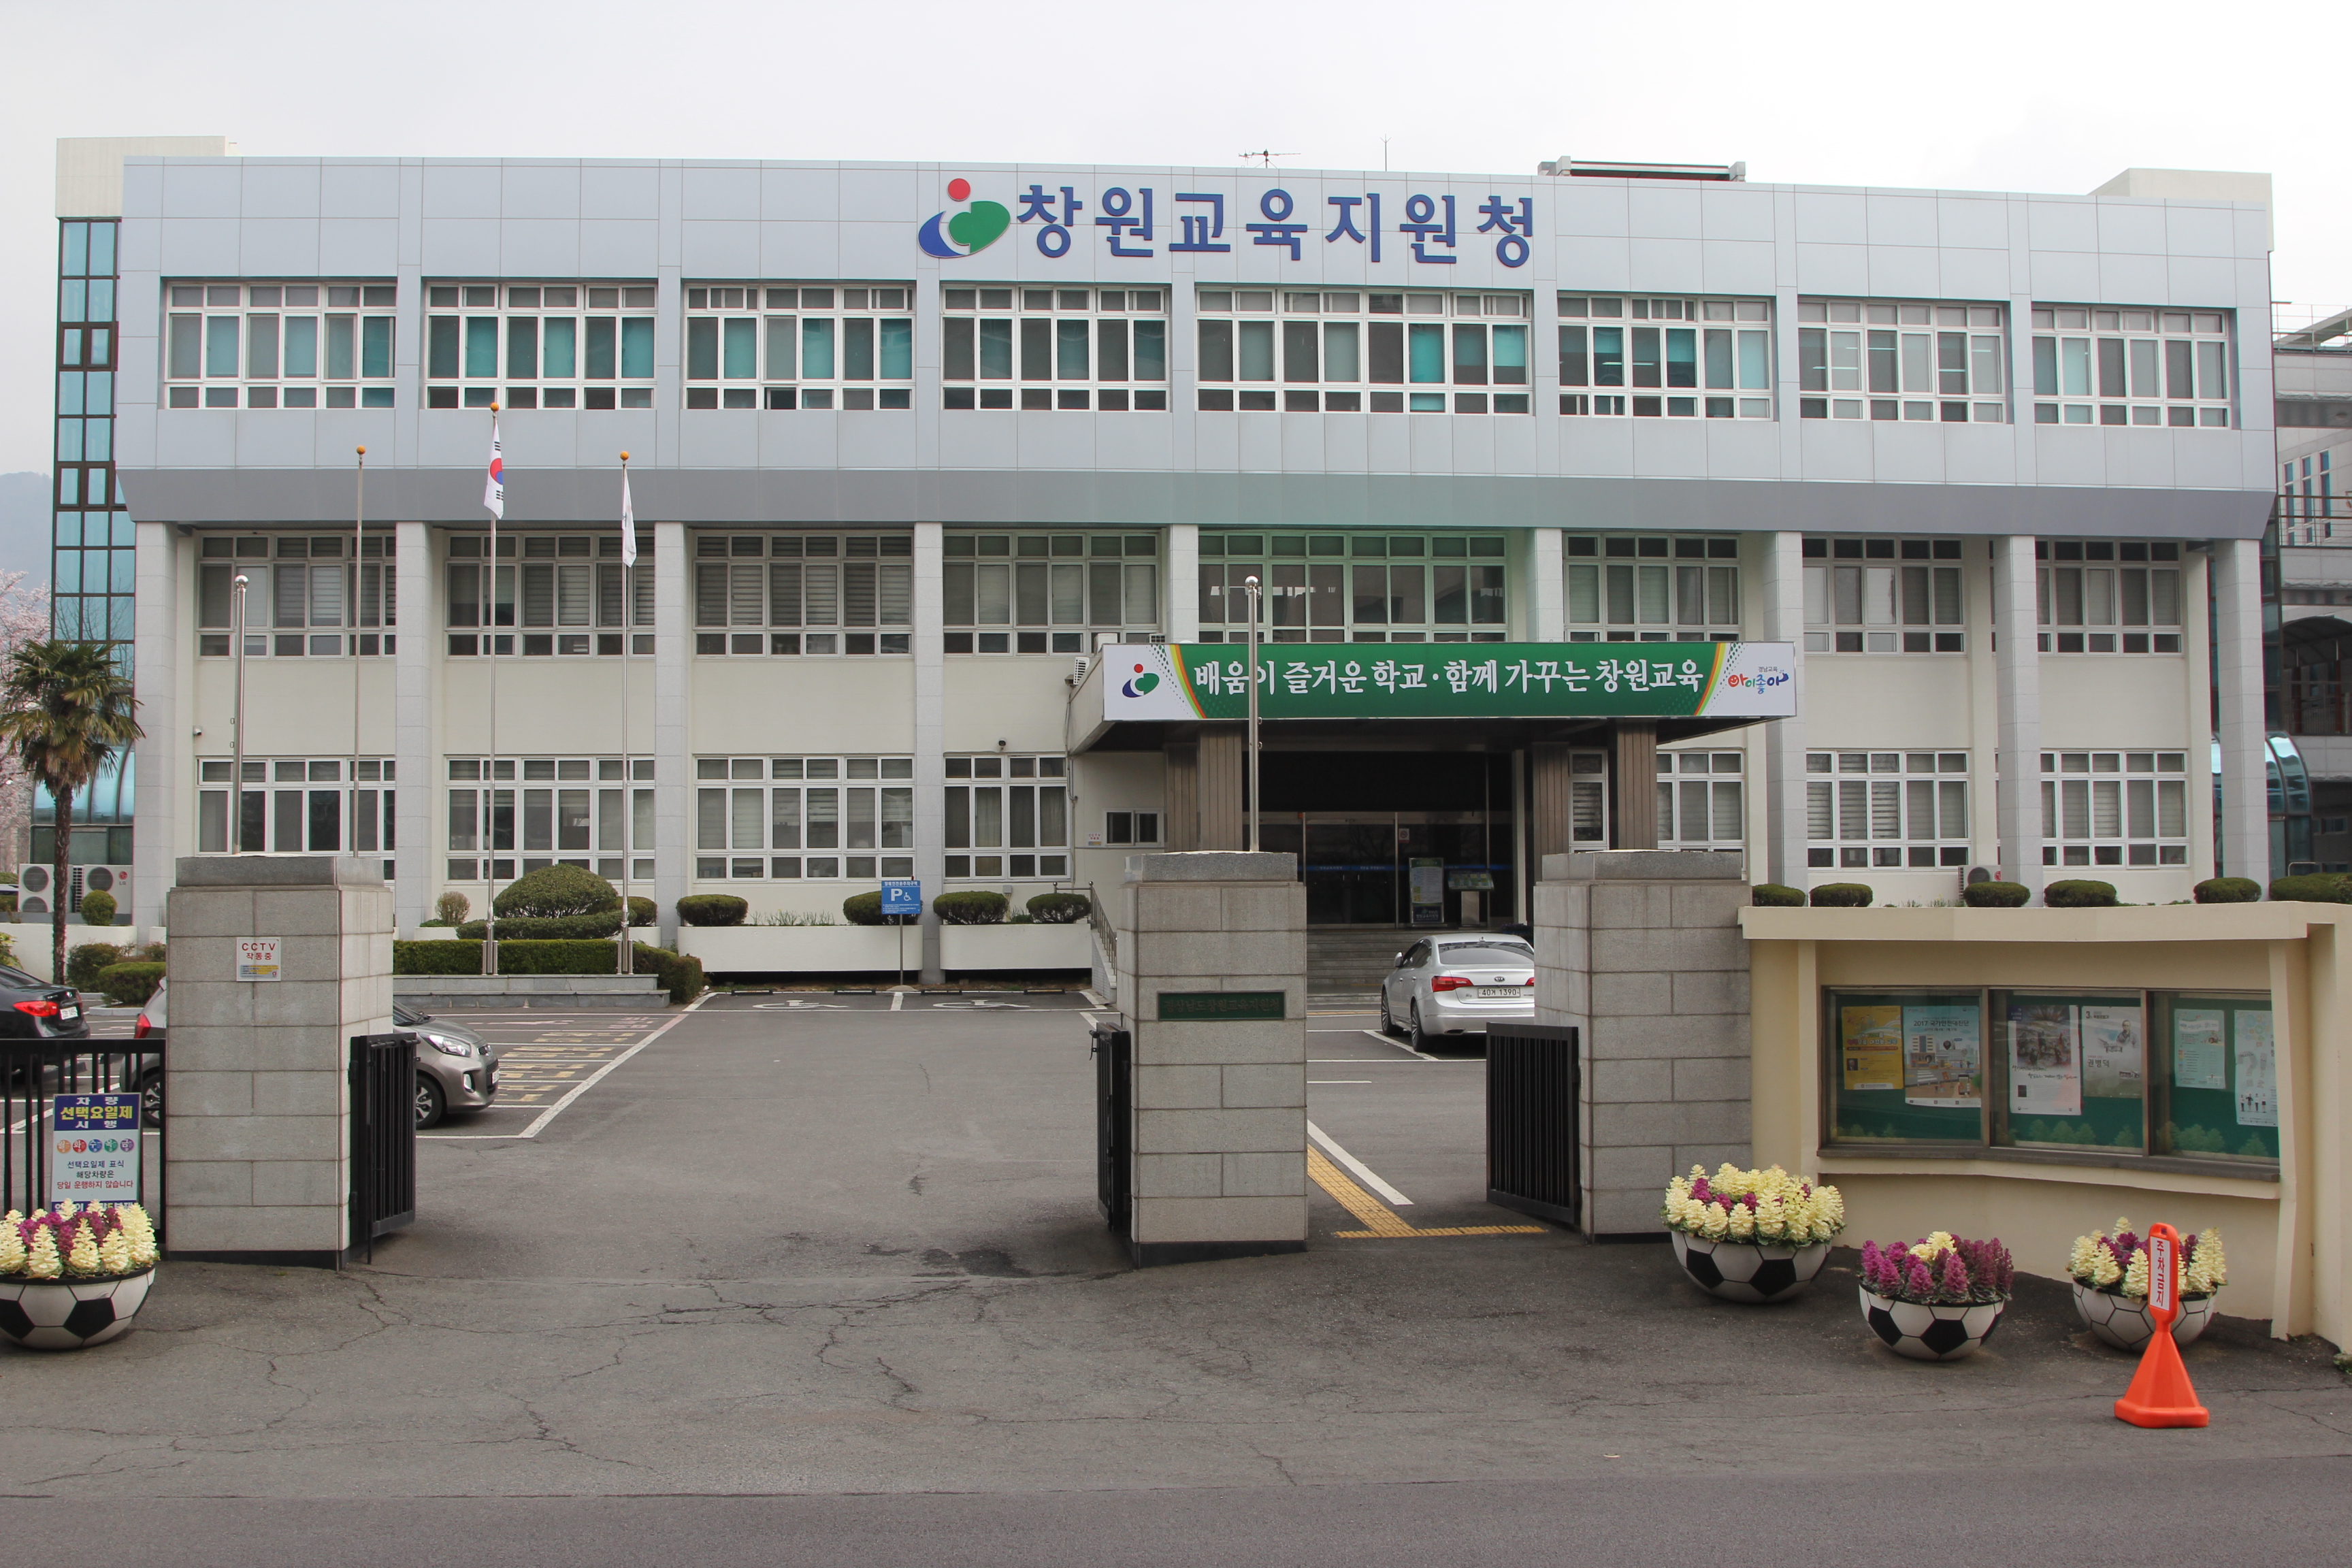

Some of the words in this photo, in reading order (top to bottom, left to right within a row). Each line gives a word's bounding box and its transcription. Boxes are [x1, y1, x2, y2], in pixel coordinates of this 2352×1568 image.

[1017, 184, 1533, 267] 창원교육지원청
[1194, 660, 1275, 695] 배움이
[1283, 659, 1367, 695] 즐거운
[1505, 659, 1595, 694] 가꾸는
[1595, 659, 1703, 693] 창원교육
[242, 943, 276, 951] CCTV
[246, 952, 272, 960] 작동중
[2087, 1059, 2110, 1068] 권병덕
[61, 1105, 133, 1120] 선택요일제
[67, 1160, 105, 1169] 선택요일제
[76, 1170, 114, 1179] 해당차량은
[57, 1181, 71, 1190] 당일
[74, 1181, 102, 1189] 운행하지
[105, 1180, 133, 1189] 않습니다
[2156, 1240, 2166, 1307] 주차금지
